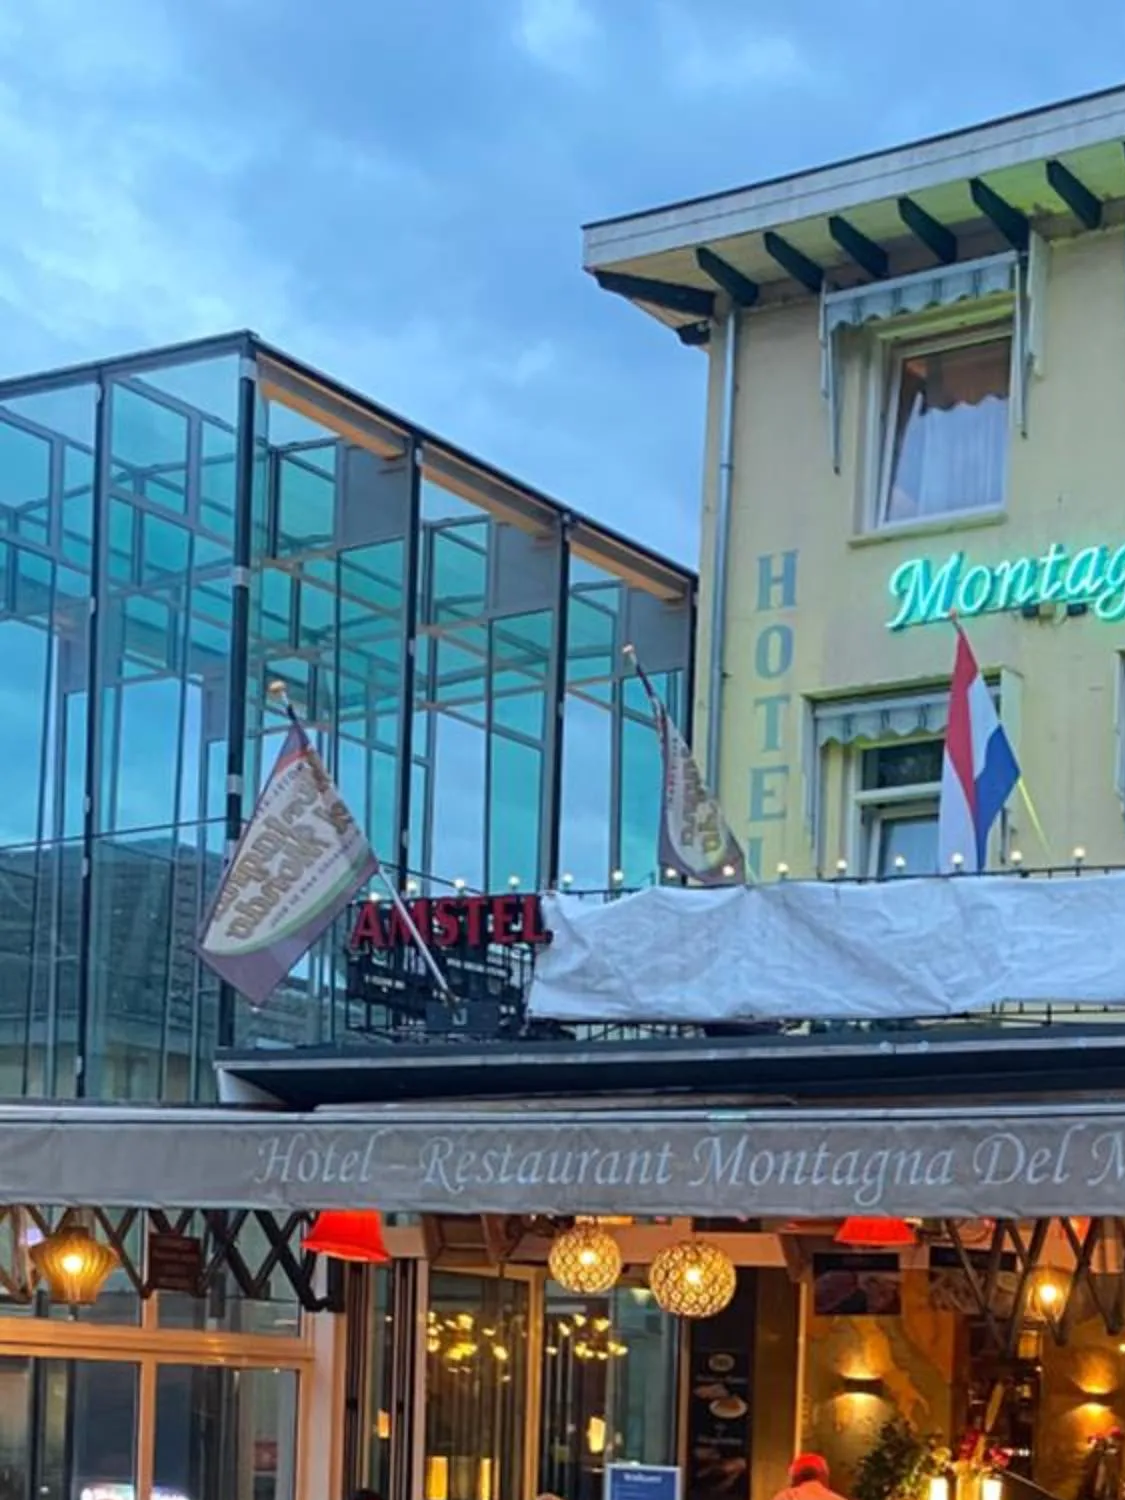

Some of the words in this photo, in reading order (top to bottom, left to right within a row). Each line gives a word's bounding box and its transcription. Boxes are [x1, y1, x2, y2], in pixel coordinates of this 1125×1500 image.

[351, 895, 553, 949] AMSTEL
[254, 1128, 389, 1184] Hotel
[419, 1136, 673, 1195] Restaurant
[689, 1131, 954, 1207] Montagna
[972, 1123, 1086, 1186] Del
